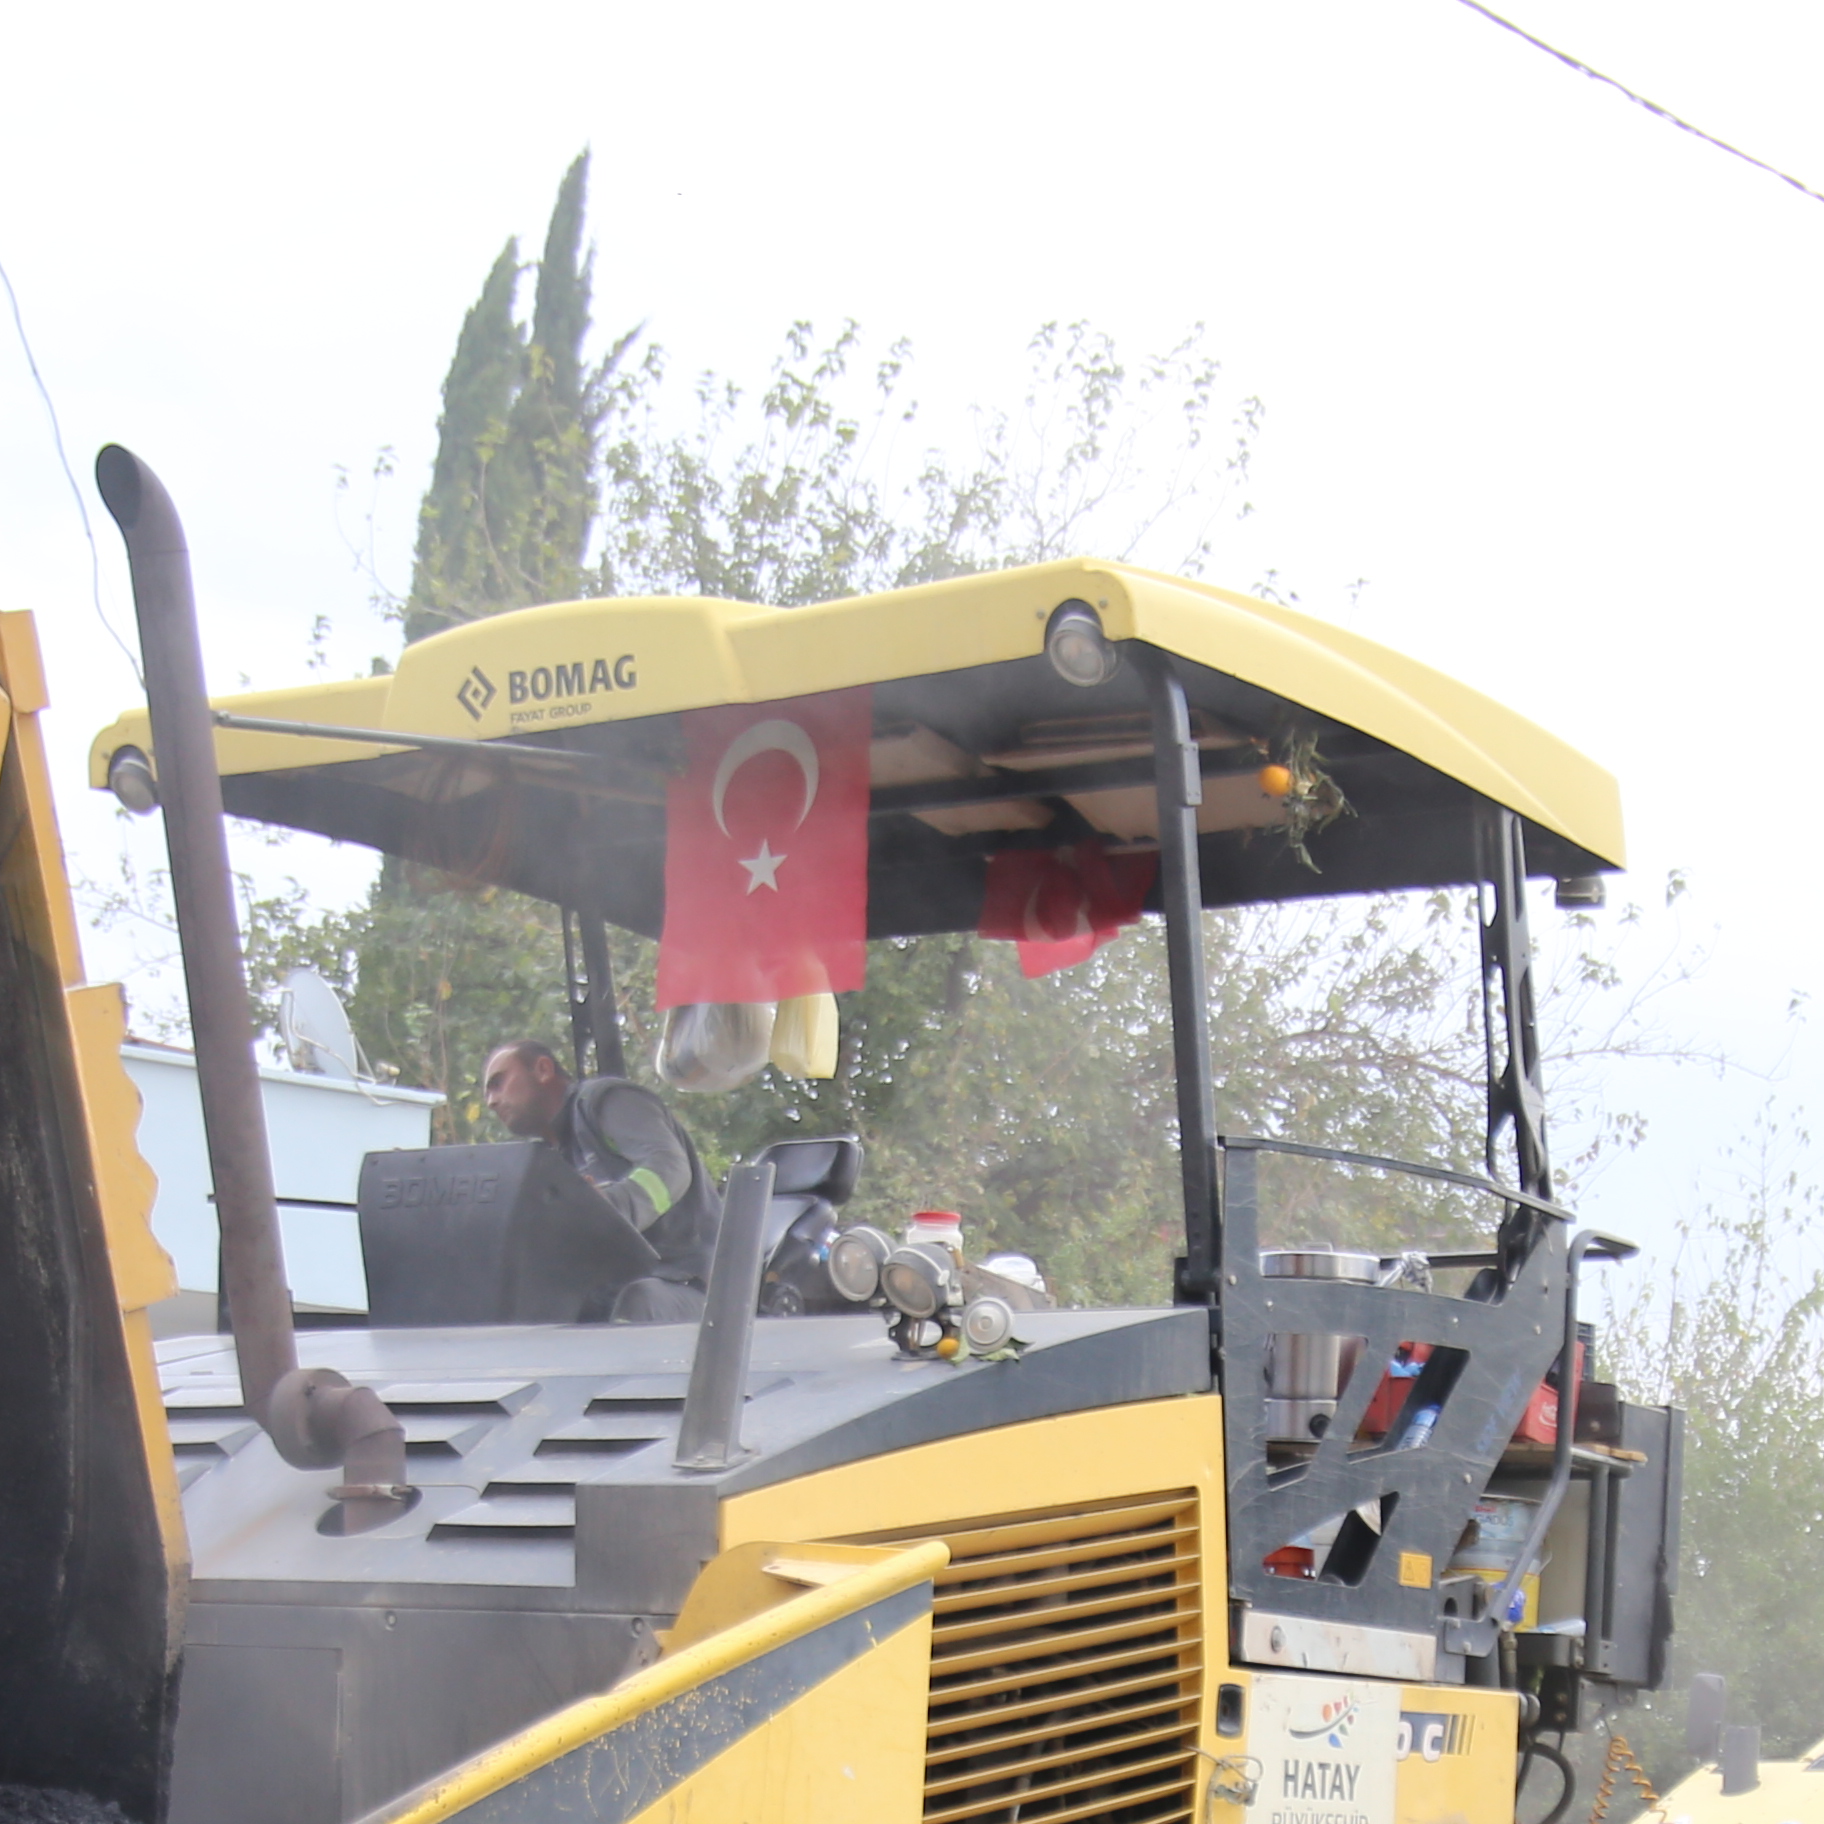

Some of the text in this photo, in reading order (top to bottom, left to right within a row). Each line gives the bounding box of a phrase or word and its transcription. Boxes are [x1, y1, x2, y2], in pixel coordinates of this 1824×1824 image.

[508, 654, 638, 704] BOMAG
[510, 702, 593, 725] FAYAT GROUP
[379, 1173, 500, 1210] BOMAG
[1282, 1759, 1360, 1801] HATAY
